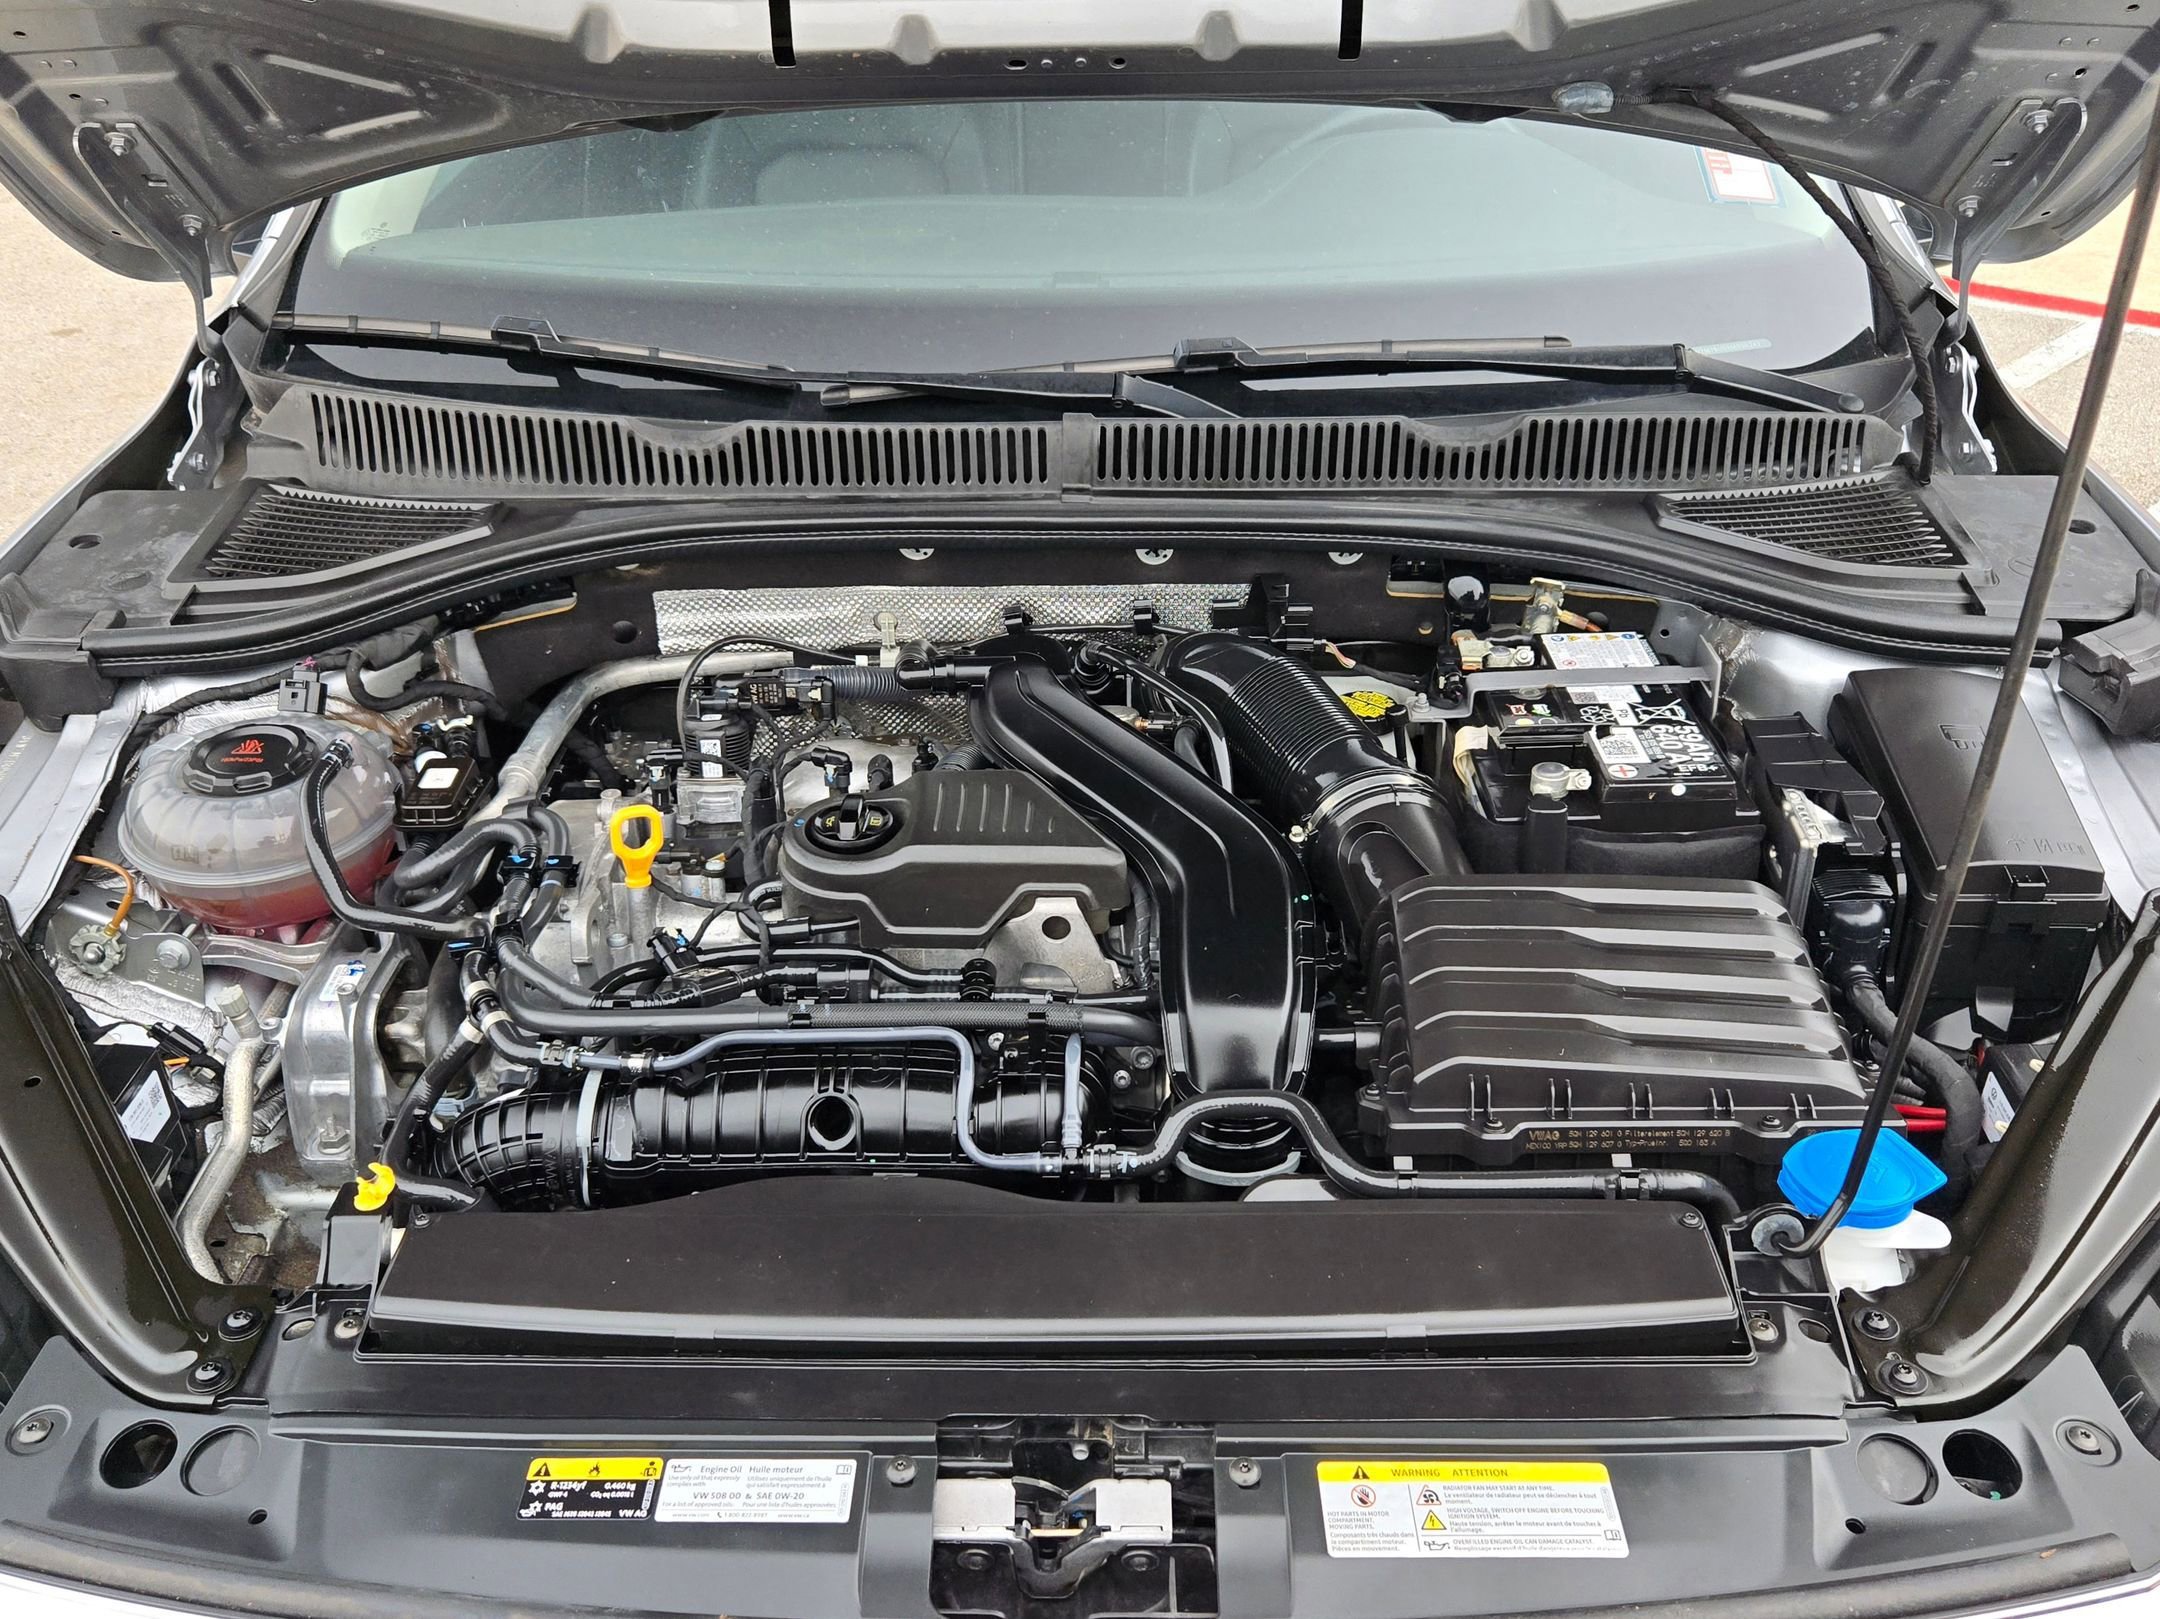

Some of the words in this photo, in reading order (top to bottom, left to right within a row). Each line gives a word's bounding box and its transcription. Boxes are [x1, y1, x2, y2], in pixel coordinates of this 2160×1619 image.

[1616, 709, 1628, 718] Pb
[1650, 725, 1683, 749] 640
[1674, 726, 1714, 761] 59Ah
[1665, 752, 1691, 764] A
[1678, 764, 1718, 772] EFB+
[700, 1466, 728, 1475] Engine
[1391, 1469, 1440, 1477] WARNING
[1452, 1469, 1508, 1477] ATTENTION
[627, 1482, 636, 1491] kg
[756, 1492, 772, 1500] SAE
[775, 1492, 805, 1500] 0W-20
[544, 1503, 563, 1511] PAG
